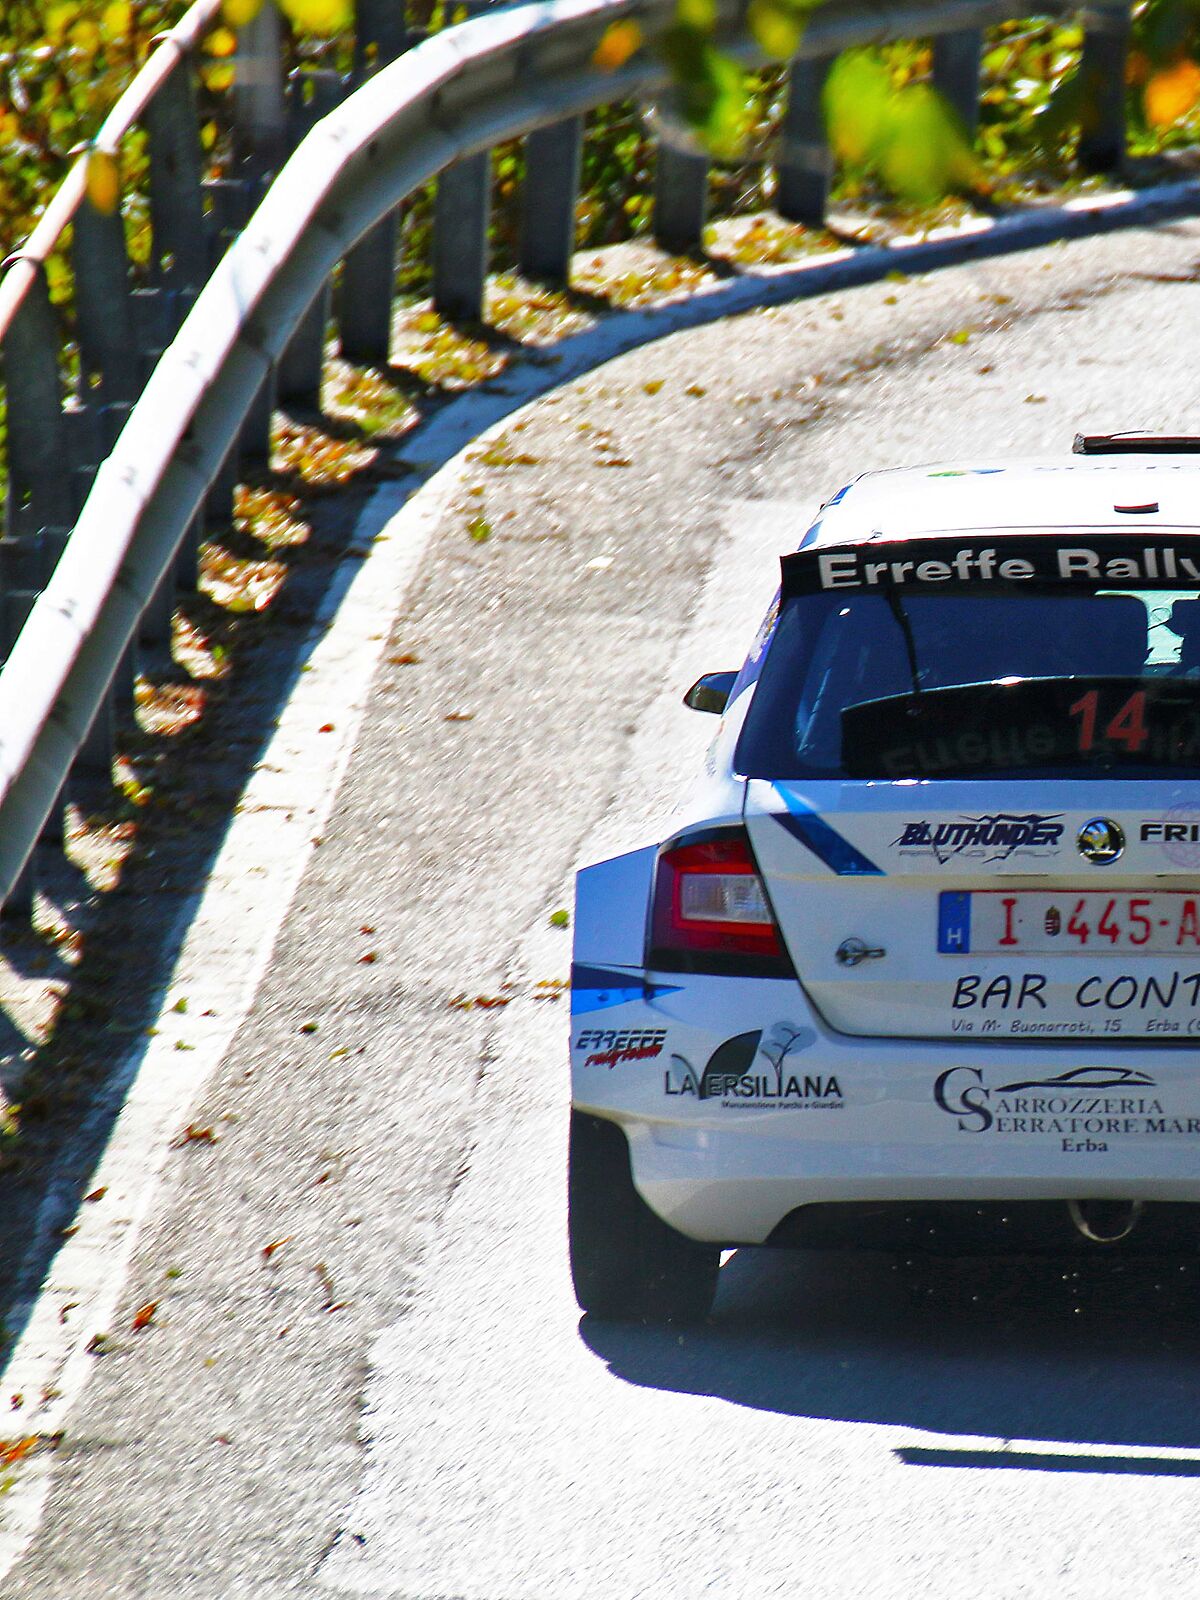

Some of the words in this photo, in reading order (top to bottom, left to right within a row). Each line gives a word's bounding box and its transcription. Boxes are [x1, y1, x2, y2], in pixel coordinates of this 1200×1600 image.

[818, 548, 1036, 589] Erreffe
[1069, 690, 1150, 752] 14
[897, 820, 1066, 847] BLUTHUNDER
[946, 928, 963, 945] H
[952, 973, 1048, 1010] BAR
[952, 1018, 975, 1032] Via
[1104, 1018, 1122, 1033] 15
[1146, 1019, 1180, 1033] Erba
[1061, 1138, 1109, 1153] Erba
